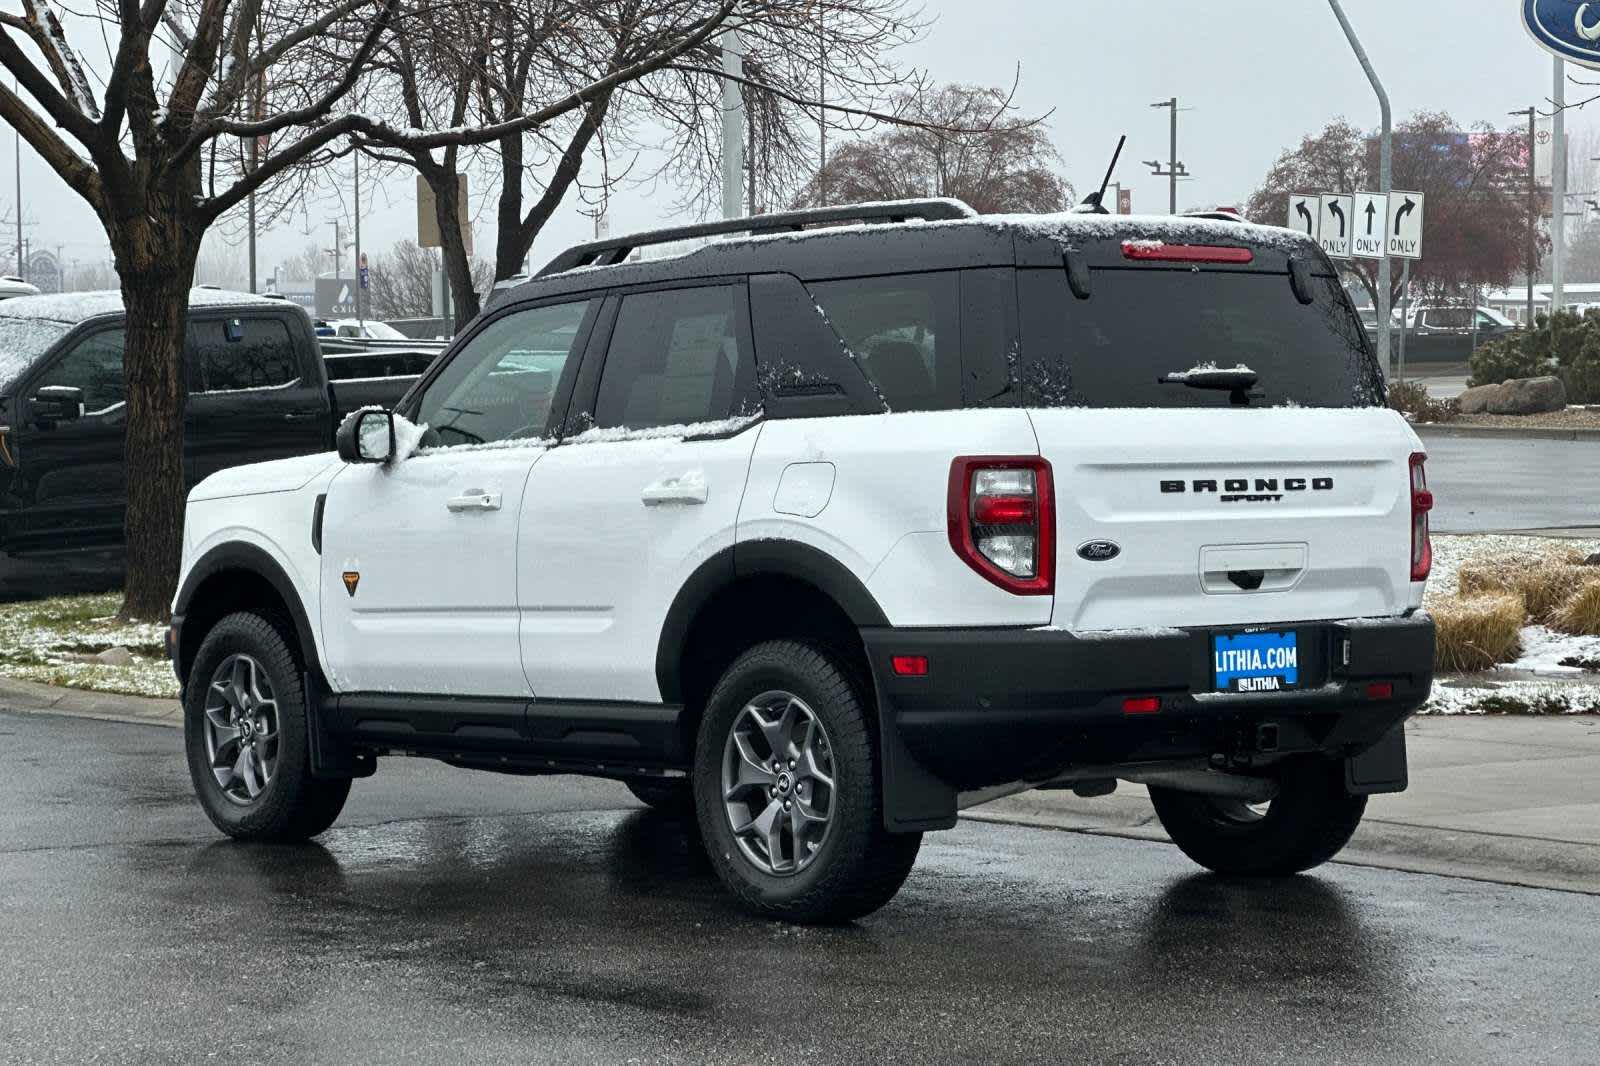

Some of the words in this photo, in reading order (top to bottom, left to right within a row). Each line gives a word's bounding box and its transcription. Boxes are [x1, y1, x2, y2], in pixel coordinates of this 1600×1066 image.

[1322, 239, 1347, 253] ONLY
[1356, 238, 1381, 253] ONLY
[1390, 238, 1416, 253] ONLY
[1160, 477, 1334, 493] BRONCO
[1220, 494, 1283, 502] SPORT
[1087, 543, 1113, 557] Ford
[1215, 646, 1297, 673] LITHIA.COM
[1247, 676, 1280, 692] LITHIA
